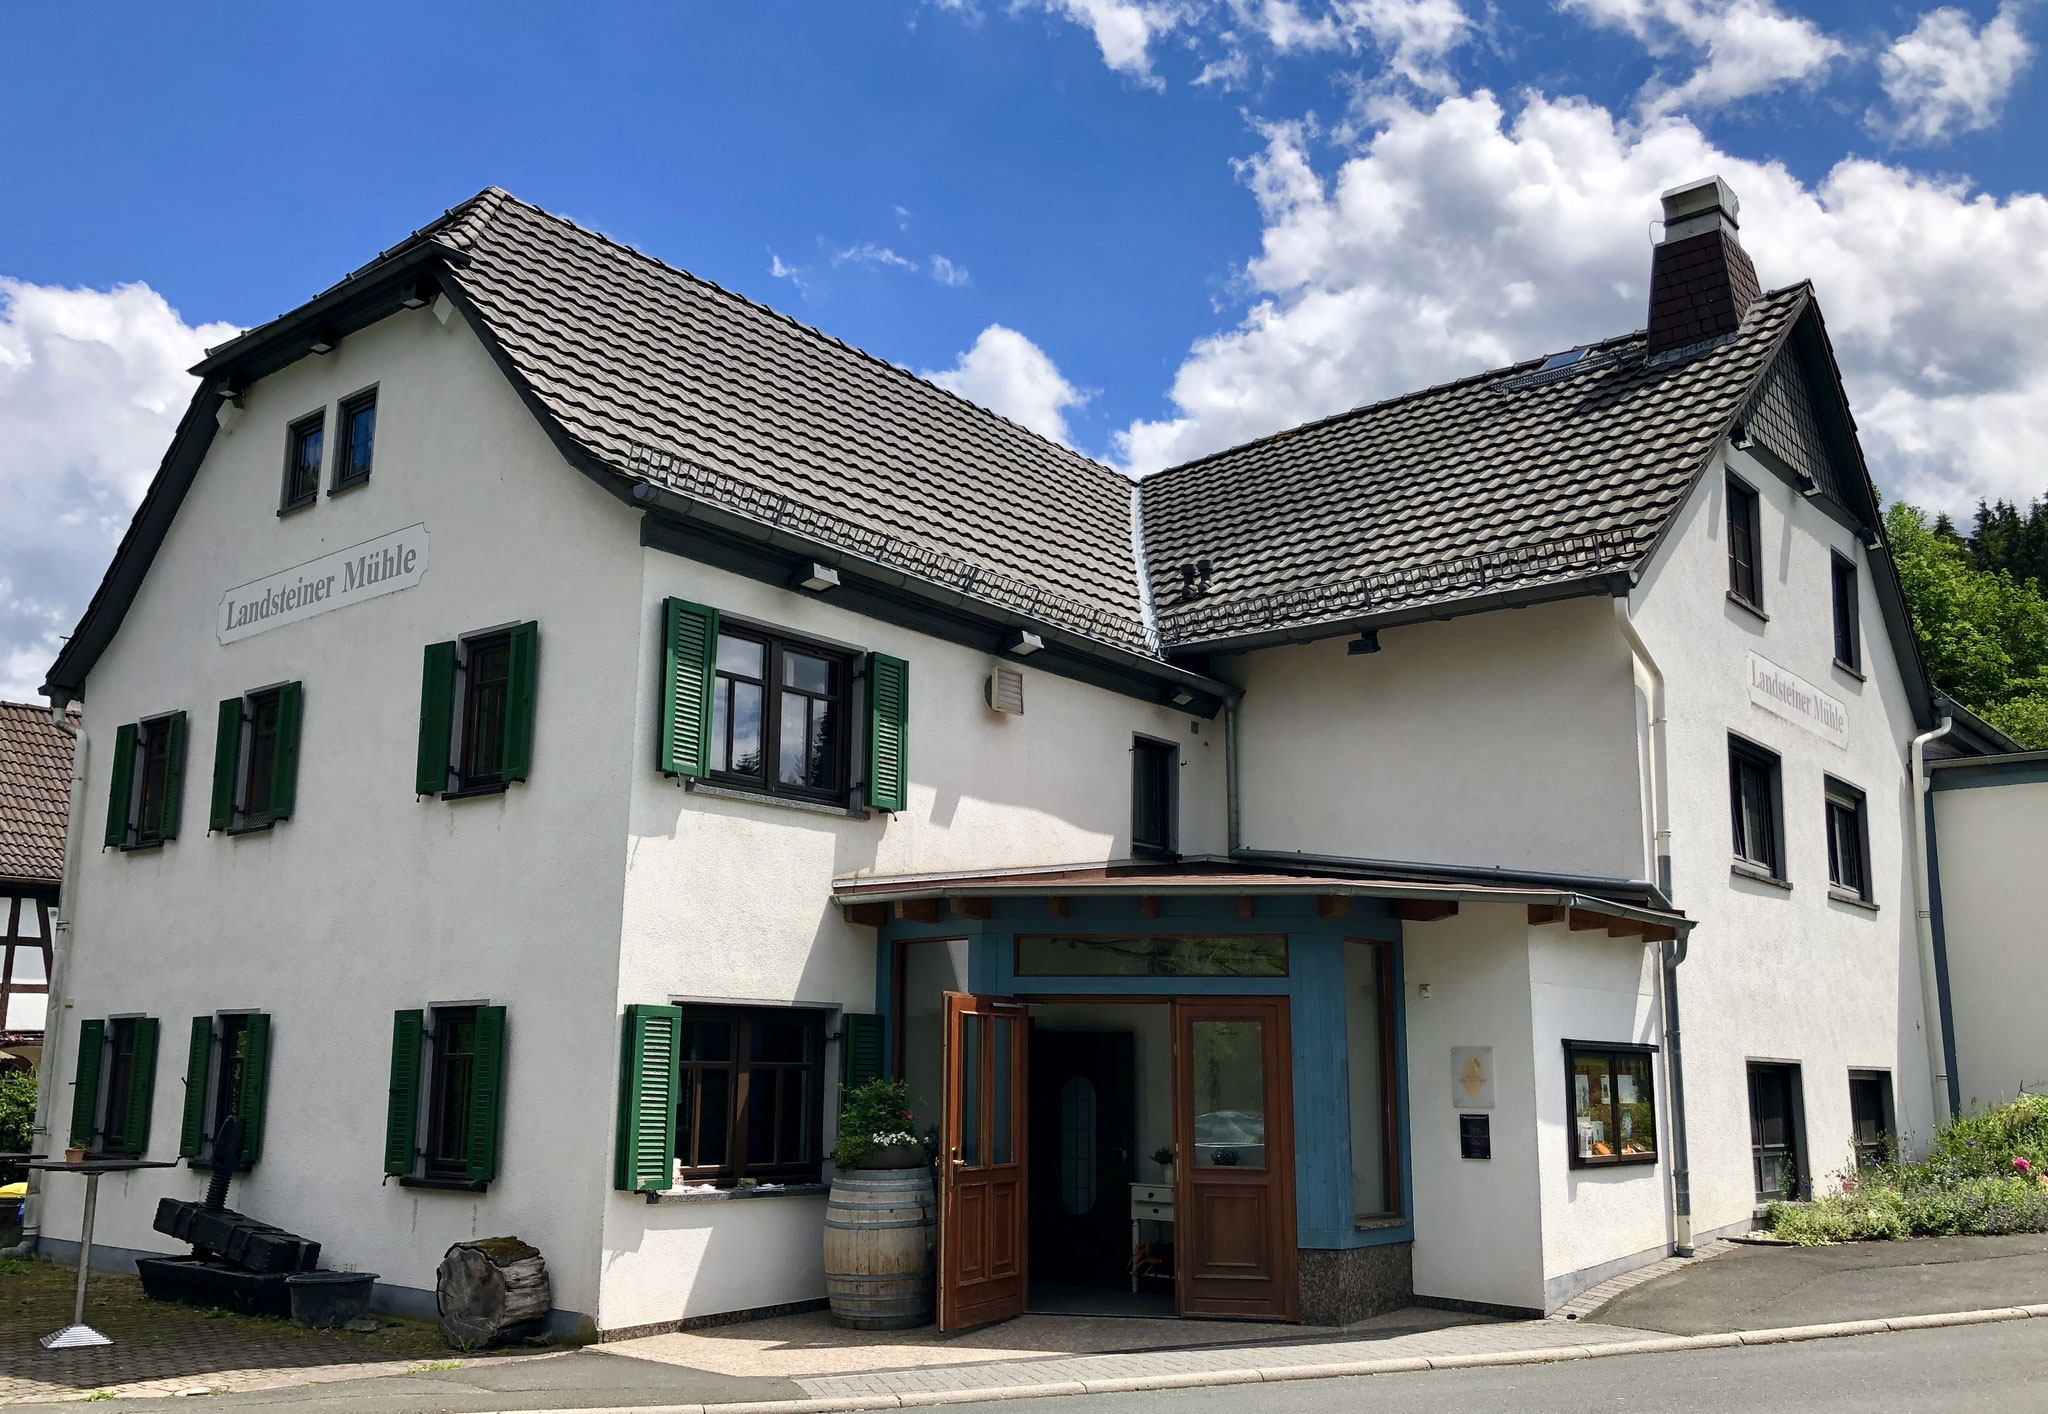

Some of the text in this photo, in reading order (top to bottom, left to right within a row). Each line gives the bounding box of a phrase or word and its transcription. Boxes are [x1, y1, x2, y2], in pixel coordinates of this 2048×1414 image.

[225, 544, 417, 631] Landsteiner Mühle
[1751, 659, 1844, 734] Landsteiner Mühle
